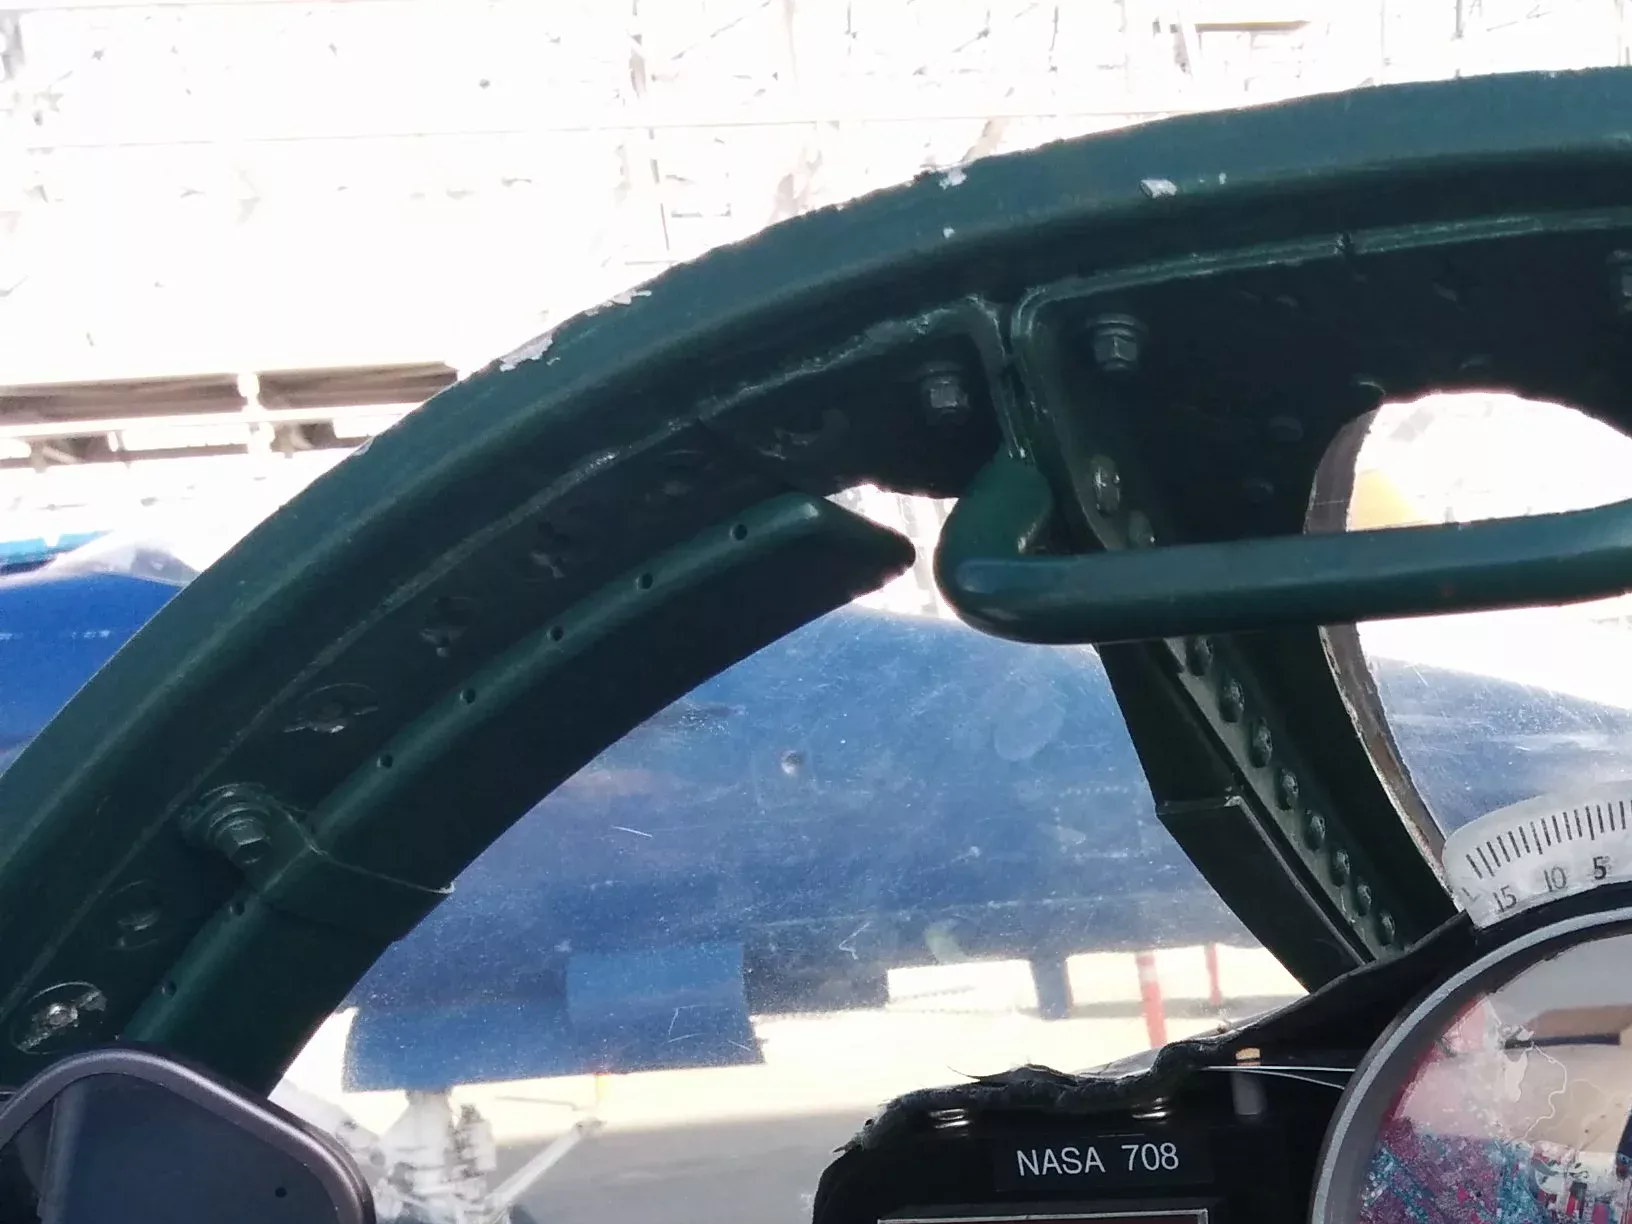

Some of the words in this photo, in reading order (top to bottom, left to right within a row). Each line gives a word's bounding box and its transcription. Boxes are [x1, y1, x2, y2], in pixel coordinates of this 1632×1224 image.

[1494, 885, 1517, 911] 15
[1544, 867, 1567, 893] 10
[1593, 856, 1612, 880] 5
[1017, 1146, 1106, 1176] NASA
[1122, 1143, 1179, 1173] 708
